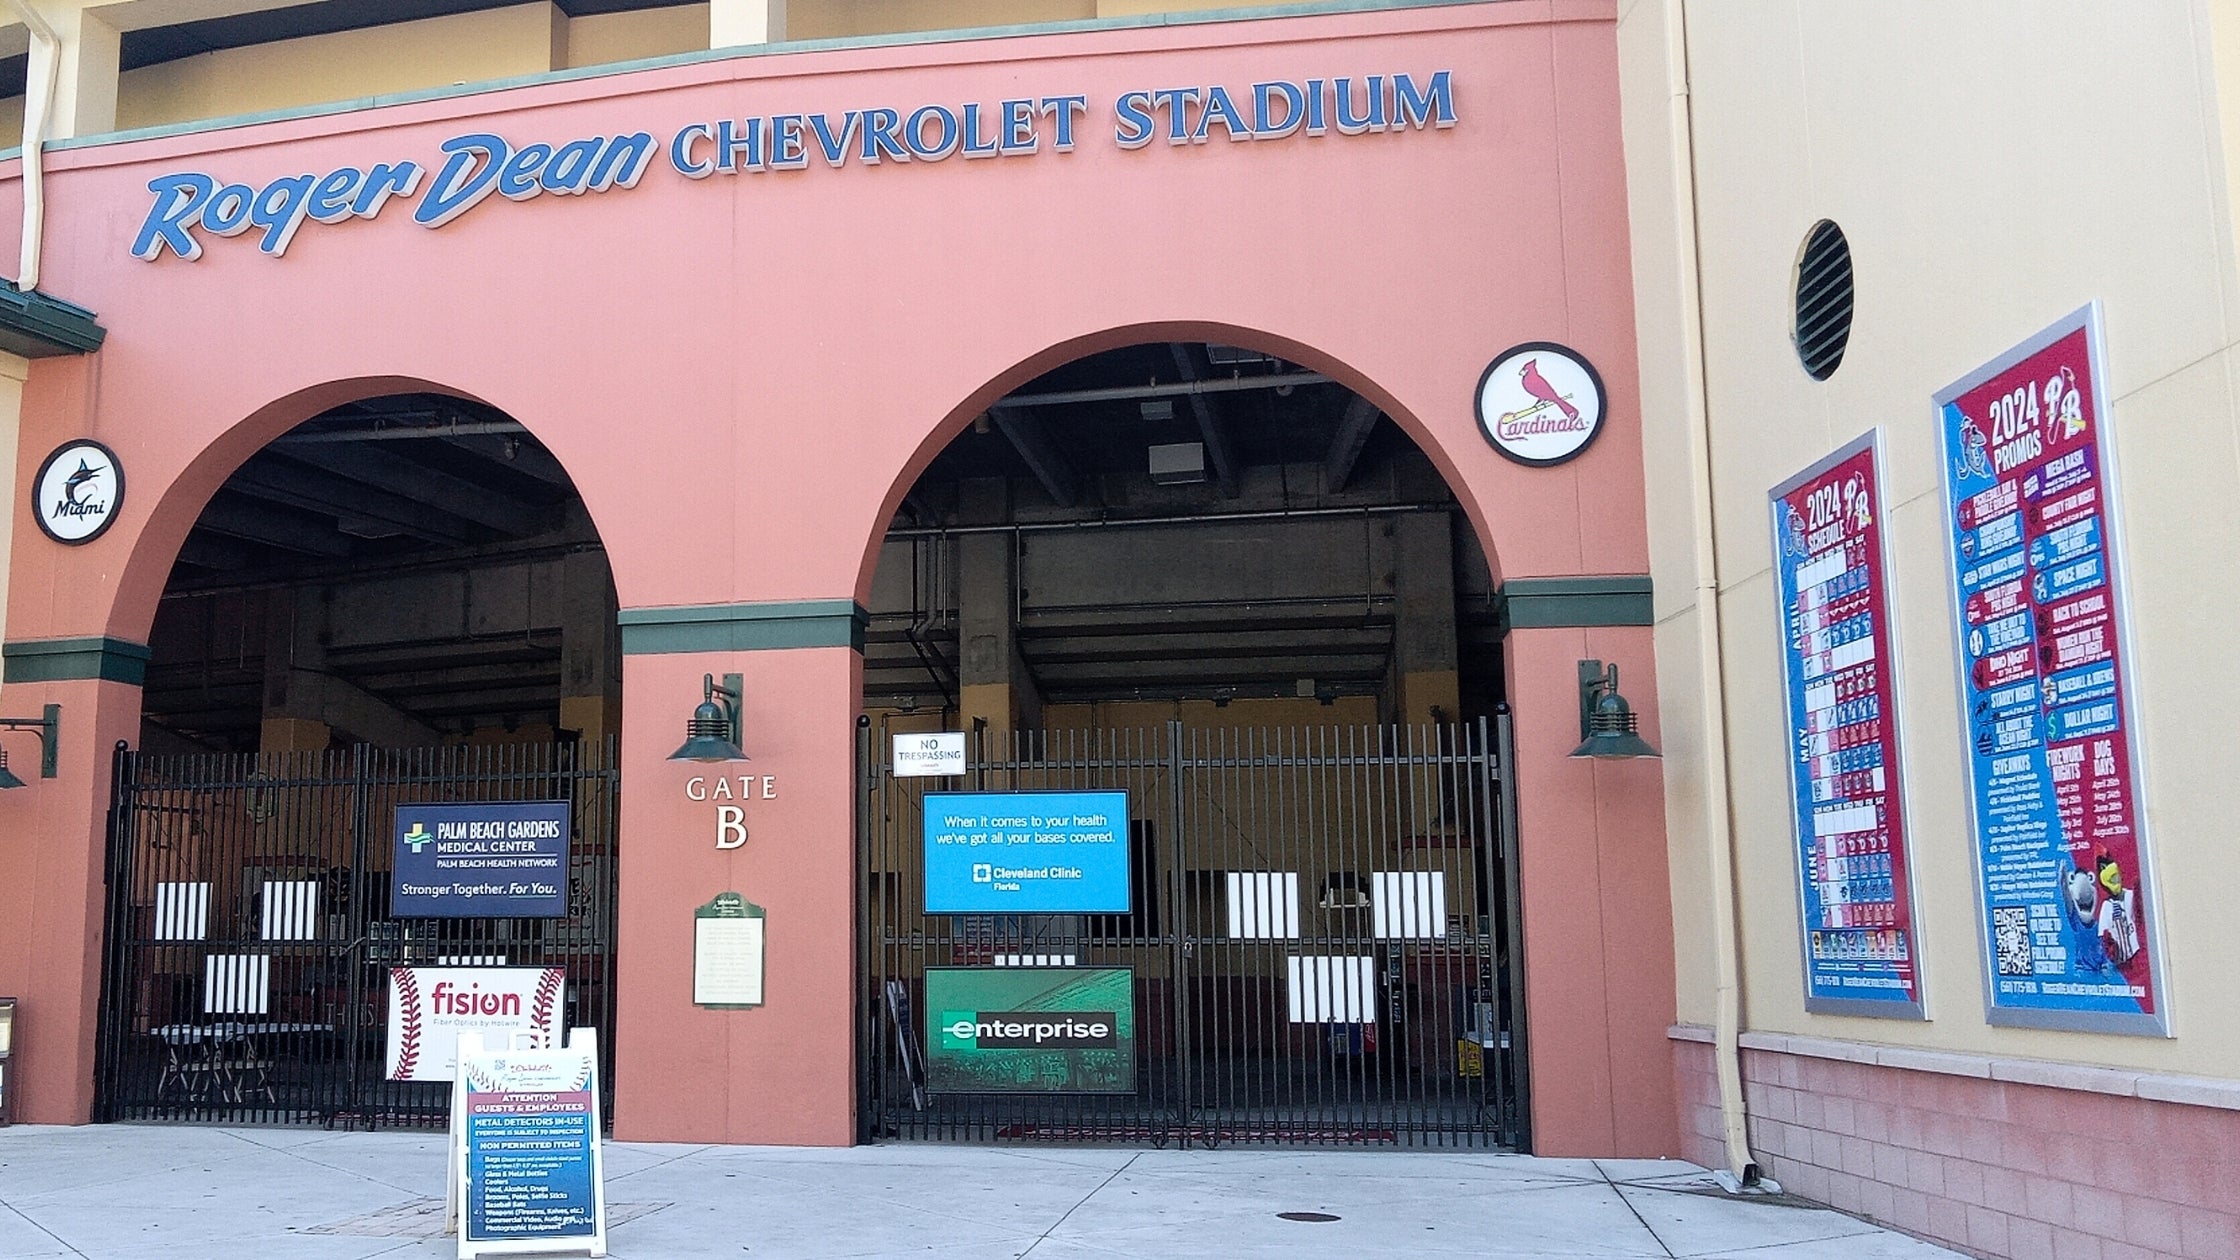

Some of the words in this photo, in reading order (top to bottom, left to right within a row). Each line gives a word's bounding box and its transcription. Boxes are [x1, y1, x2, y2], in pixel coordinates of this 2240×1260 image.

[129, 160, 426, 262] Roger
[412, 131, 659, 229] Dean
[670, 94, 1086, 180] CHEVROLET
[1115, 70, 1458, 149] STADIUM
[1990, 381, 2039, 447] 2024
[1497, 413, 1588, 441] Cardinals
[1994, 429, 2042, 475] PROMOS
[52, 500, 105, 519] Miami
[1807, 481, 1841, 532] 2024
[1808, 519, 1845, 554] SCHEDULE
[1790, 601, 1802, 650] APRIL
[2063, 708, 2090, 728] DOLLAR
[920, 739, 938, 749] NO
[1799, 728, 1810, 763] MAY
[2093, 739, 2111, 758] DOG
[898, 751, 961, 761] TRESPASSING
[1992, 754, 2031, 775] GIVEAWAYS
[2045, 744, 2084, 766] FIREWORK
[2052, 762, 2081, 782] NIGHTS
[2093, 756, 2115, 776] DAYS
[686, 775, 778, 801] GATE
[437, 822, 467, 840] PALM
[470, 821, 505, 839] BEACH
[508, 820, 559, 839] GARDENS
[716, 804, 749, 850] B
[944, 815, 977, 828] When
[981, 816, 988, 828] it
[991, 816, 1028, 828] comes
[1031, 815, 1042, 827] to
[1045, 817, 1069, 830] your
[1073, 814, 1107, 827] health
[437, 842, 488, 853] MEDICAL
[490, 841, 536, 852] CENTER
[936, 833, 967, 844] we've
[971, 834, 987, 846] got
[991, 832, 1003, 844] all
[1007, 833, 1031, 846] your
[1034, 832, 1067, 844] bases
[1070, 831, 1116, 843] covered.
[436, 860, 458, 868] PALM
[459, 859, 486, 868] BEACH
[487, 859, 517, 868] HEALTH
[518, 859, 558, 867] NETWORK
[993, 867, 1049, 879] Cleveland
[1050, 867, 1082, 879] Clinic
[1808, 846, 1820, 891] JUNE
[402, 883, 451, 898] Stronger
[452, 883, 507, 898] Together.
[509, 882, 528, 895] For
[531, 882, 557, 895] You.
[993, 883, 1020, 891] Florida
[431, 982, 520, 1016] fision
[480, 1019, 489, 1027] by
[952, 1018, 1109, 1043] enterprise
[475, 1104, 514, 1113] GUESTS
[525, 1103, 585, 1112] EMPLOYEES
[502, 1094, 557, 1102] ATTENTION
[504, 1118, 553, 1126] DETECTORS
[554, 1117, 584, 1125] IN-USE
[480, 1142, 500, 1150] NON
[501, 1142, 552, 1150] PERMITTED
[553, 1141, 581, 1149] ITEMS
